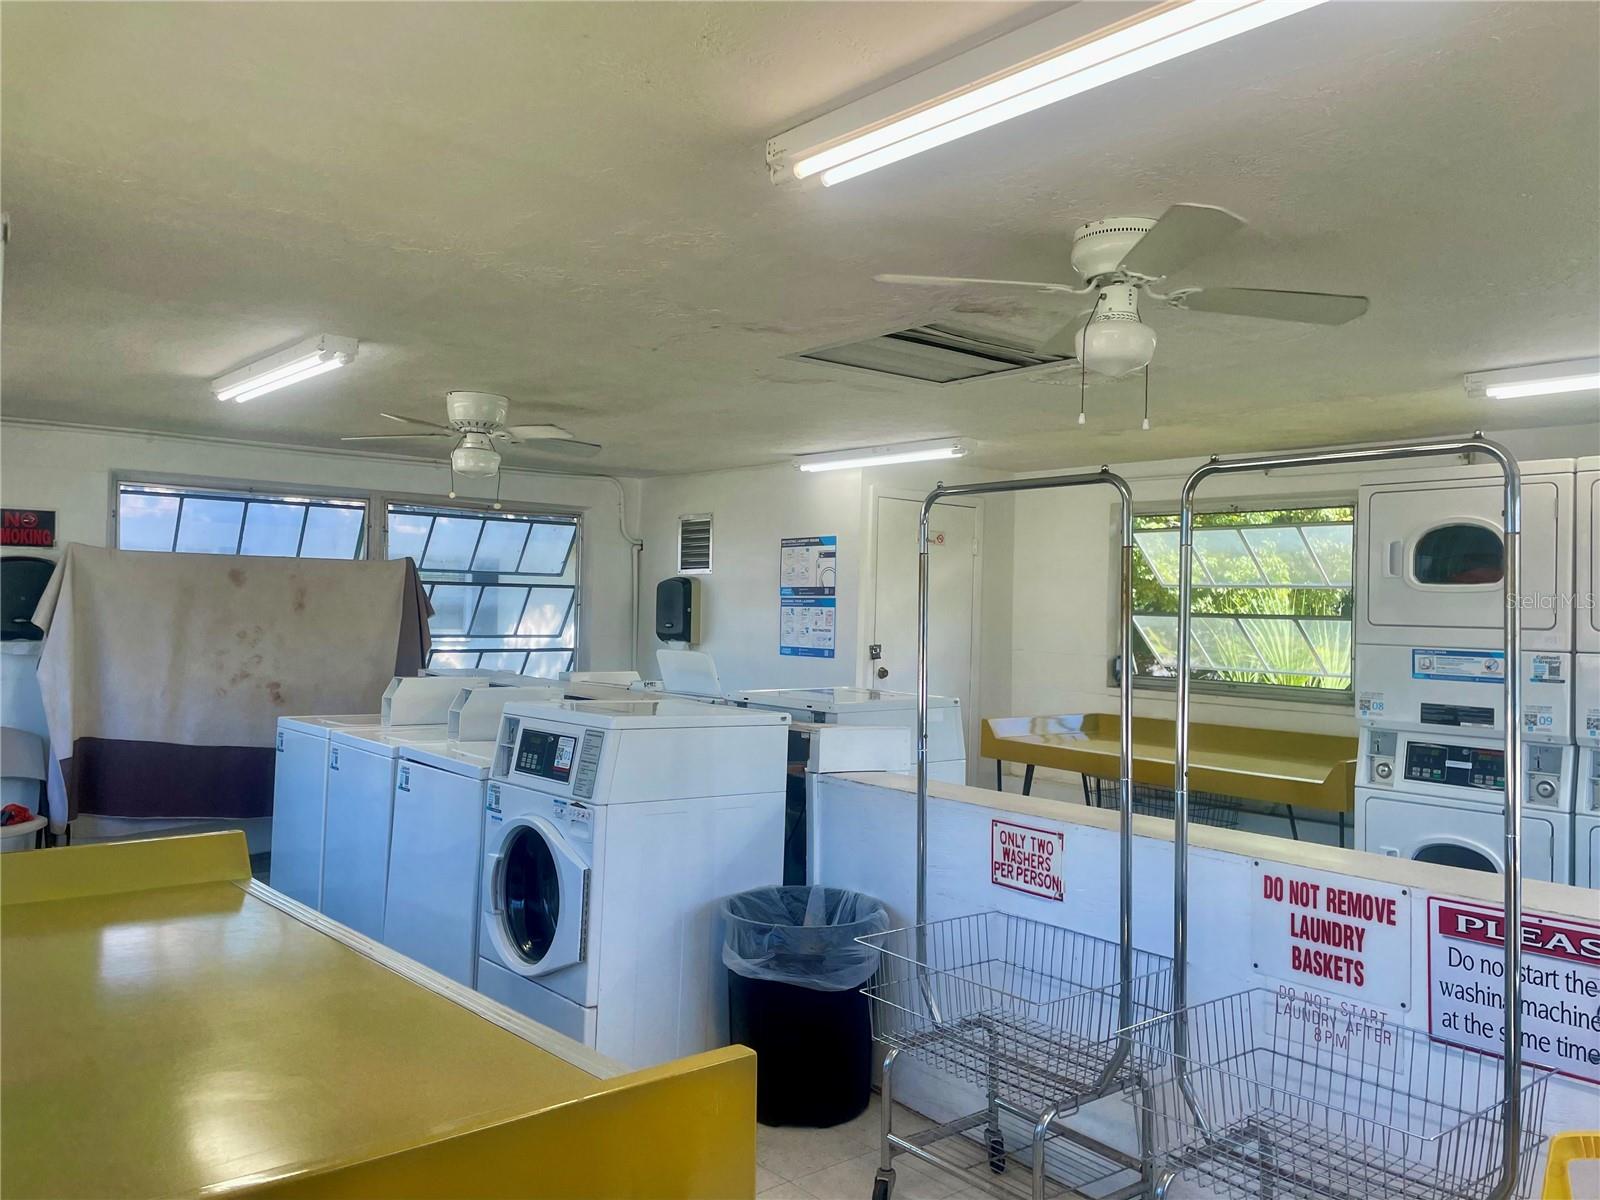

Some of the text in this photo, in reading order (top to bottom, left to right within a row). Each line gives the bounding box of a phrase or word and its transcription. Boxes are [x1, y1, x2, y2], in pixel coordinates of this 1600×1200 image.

[0, 528, 52, 545] MOKING
[4, 511, 38, 528] NO
[1372, 701, 1384, 711] 08
[1539, 716, 1553, 725] 09
[1000, 830, 1054, 856] ONLY TWO
[1002, 846, 1051, 872] WASHERS
[994, 861, 1014, 880] PER
[1263, 874, 1396, 926] DO NOT REMOVE
[1290, 912, 1366, 953] LAUNDRY
[1456, 914, 1600, 959] PLEAS
[1291, 945, 1365, 987] BASKETS
[1448, 946, 1598, 998] Do no start the
[1279, 984, 1388, 1027] DO NOT START
[1439, 980, 1505, 1009] washin
[1276, 1001, 1392, 1046] LAUNDRY AFTER
[1441, 1012, 1600, 1066] at the sme time
